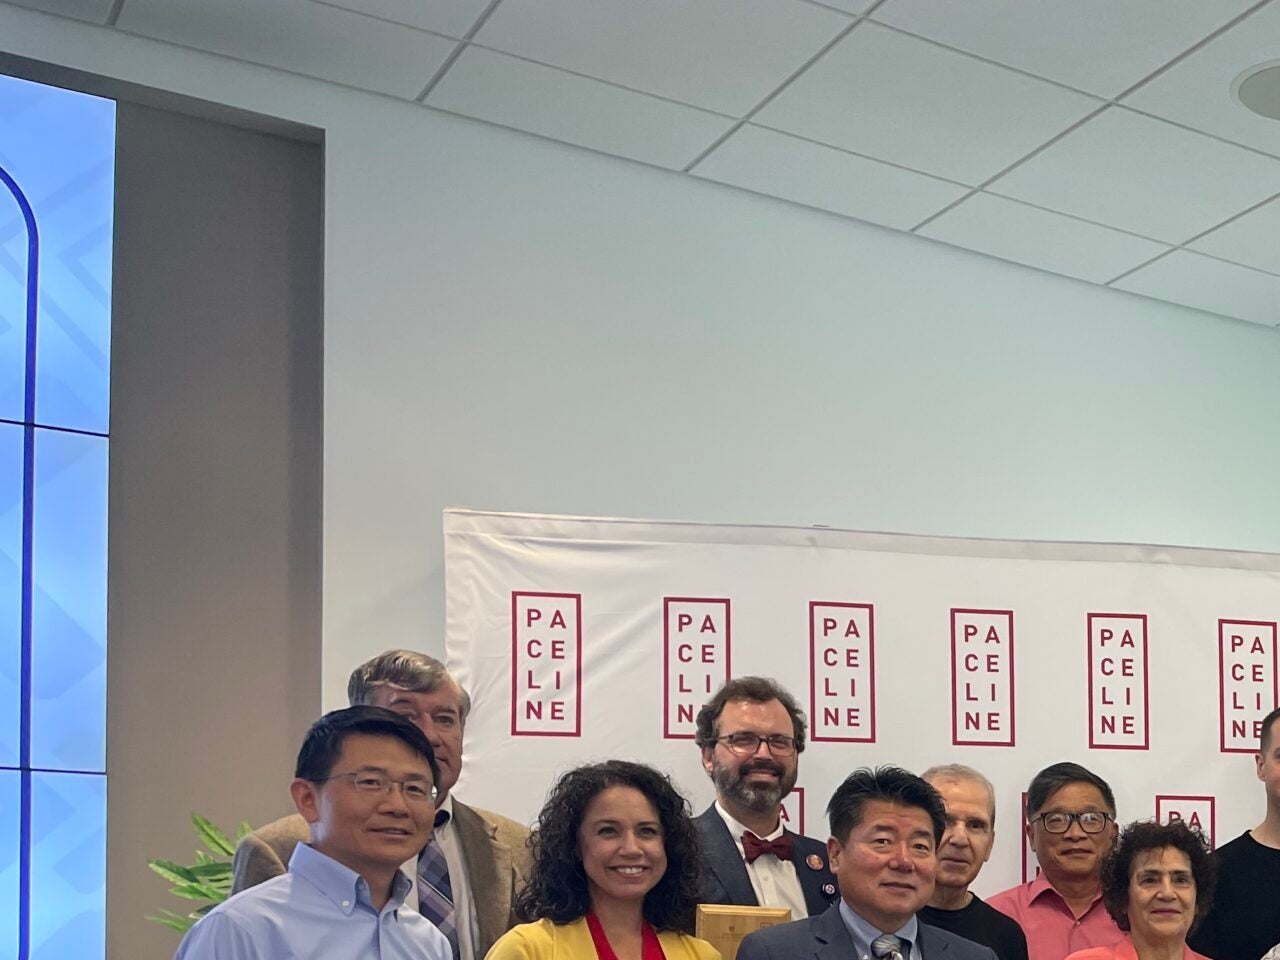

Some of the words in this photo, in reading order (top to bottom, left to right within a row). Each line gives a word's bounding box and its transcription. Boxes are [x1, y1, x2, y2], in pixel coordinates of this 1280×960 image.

[526, 608, 567, 629] PA
[678, 613, 717, 634] PA
[823, 617, 861, 638] PA
[964, 624, 1000, 644] PA
[1100, 628, 1135, 648] PA
[526, 639, 566, 660] CE
[678, 643, 715, 664] CE
[1231, 634, 1265, 655] PA
[823, 647, 859, 668] CE
[964, 653, 1000, 673] CE
[1100, 657, 1134, 677] CE
[527, 670, 561, 690] LI
[1231, 663, 1264, 683] CE
[678, 673, 711, 694] LI
[824, 677, 856, 697] LI
[965, 682, 995, 702] LI
[1101, 686, 1131, 705] LI
[1232, 691, 1261, 711] LI
[526, 700, 565, 721] NE
[823, 707, 861, 727] NE
[965, 711, 1000, 731] NE
[1101, 715, 1135, 735] NE
[1232, 719, 1264, 739] NE
